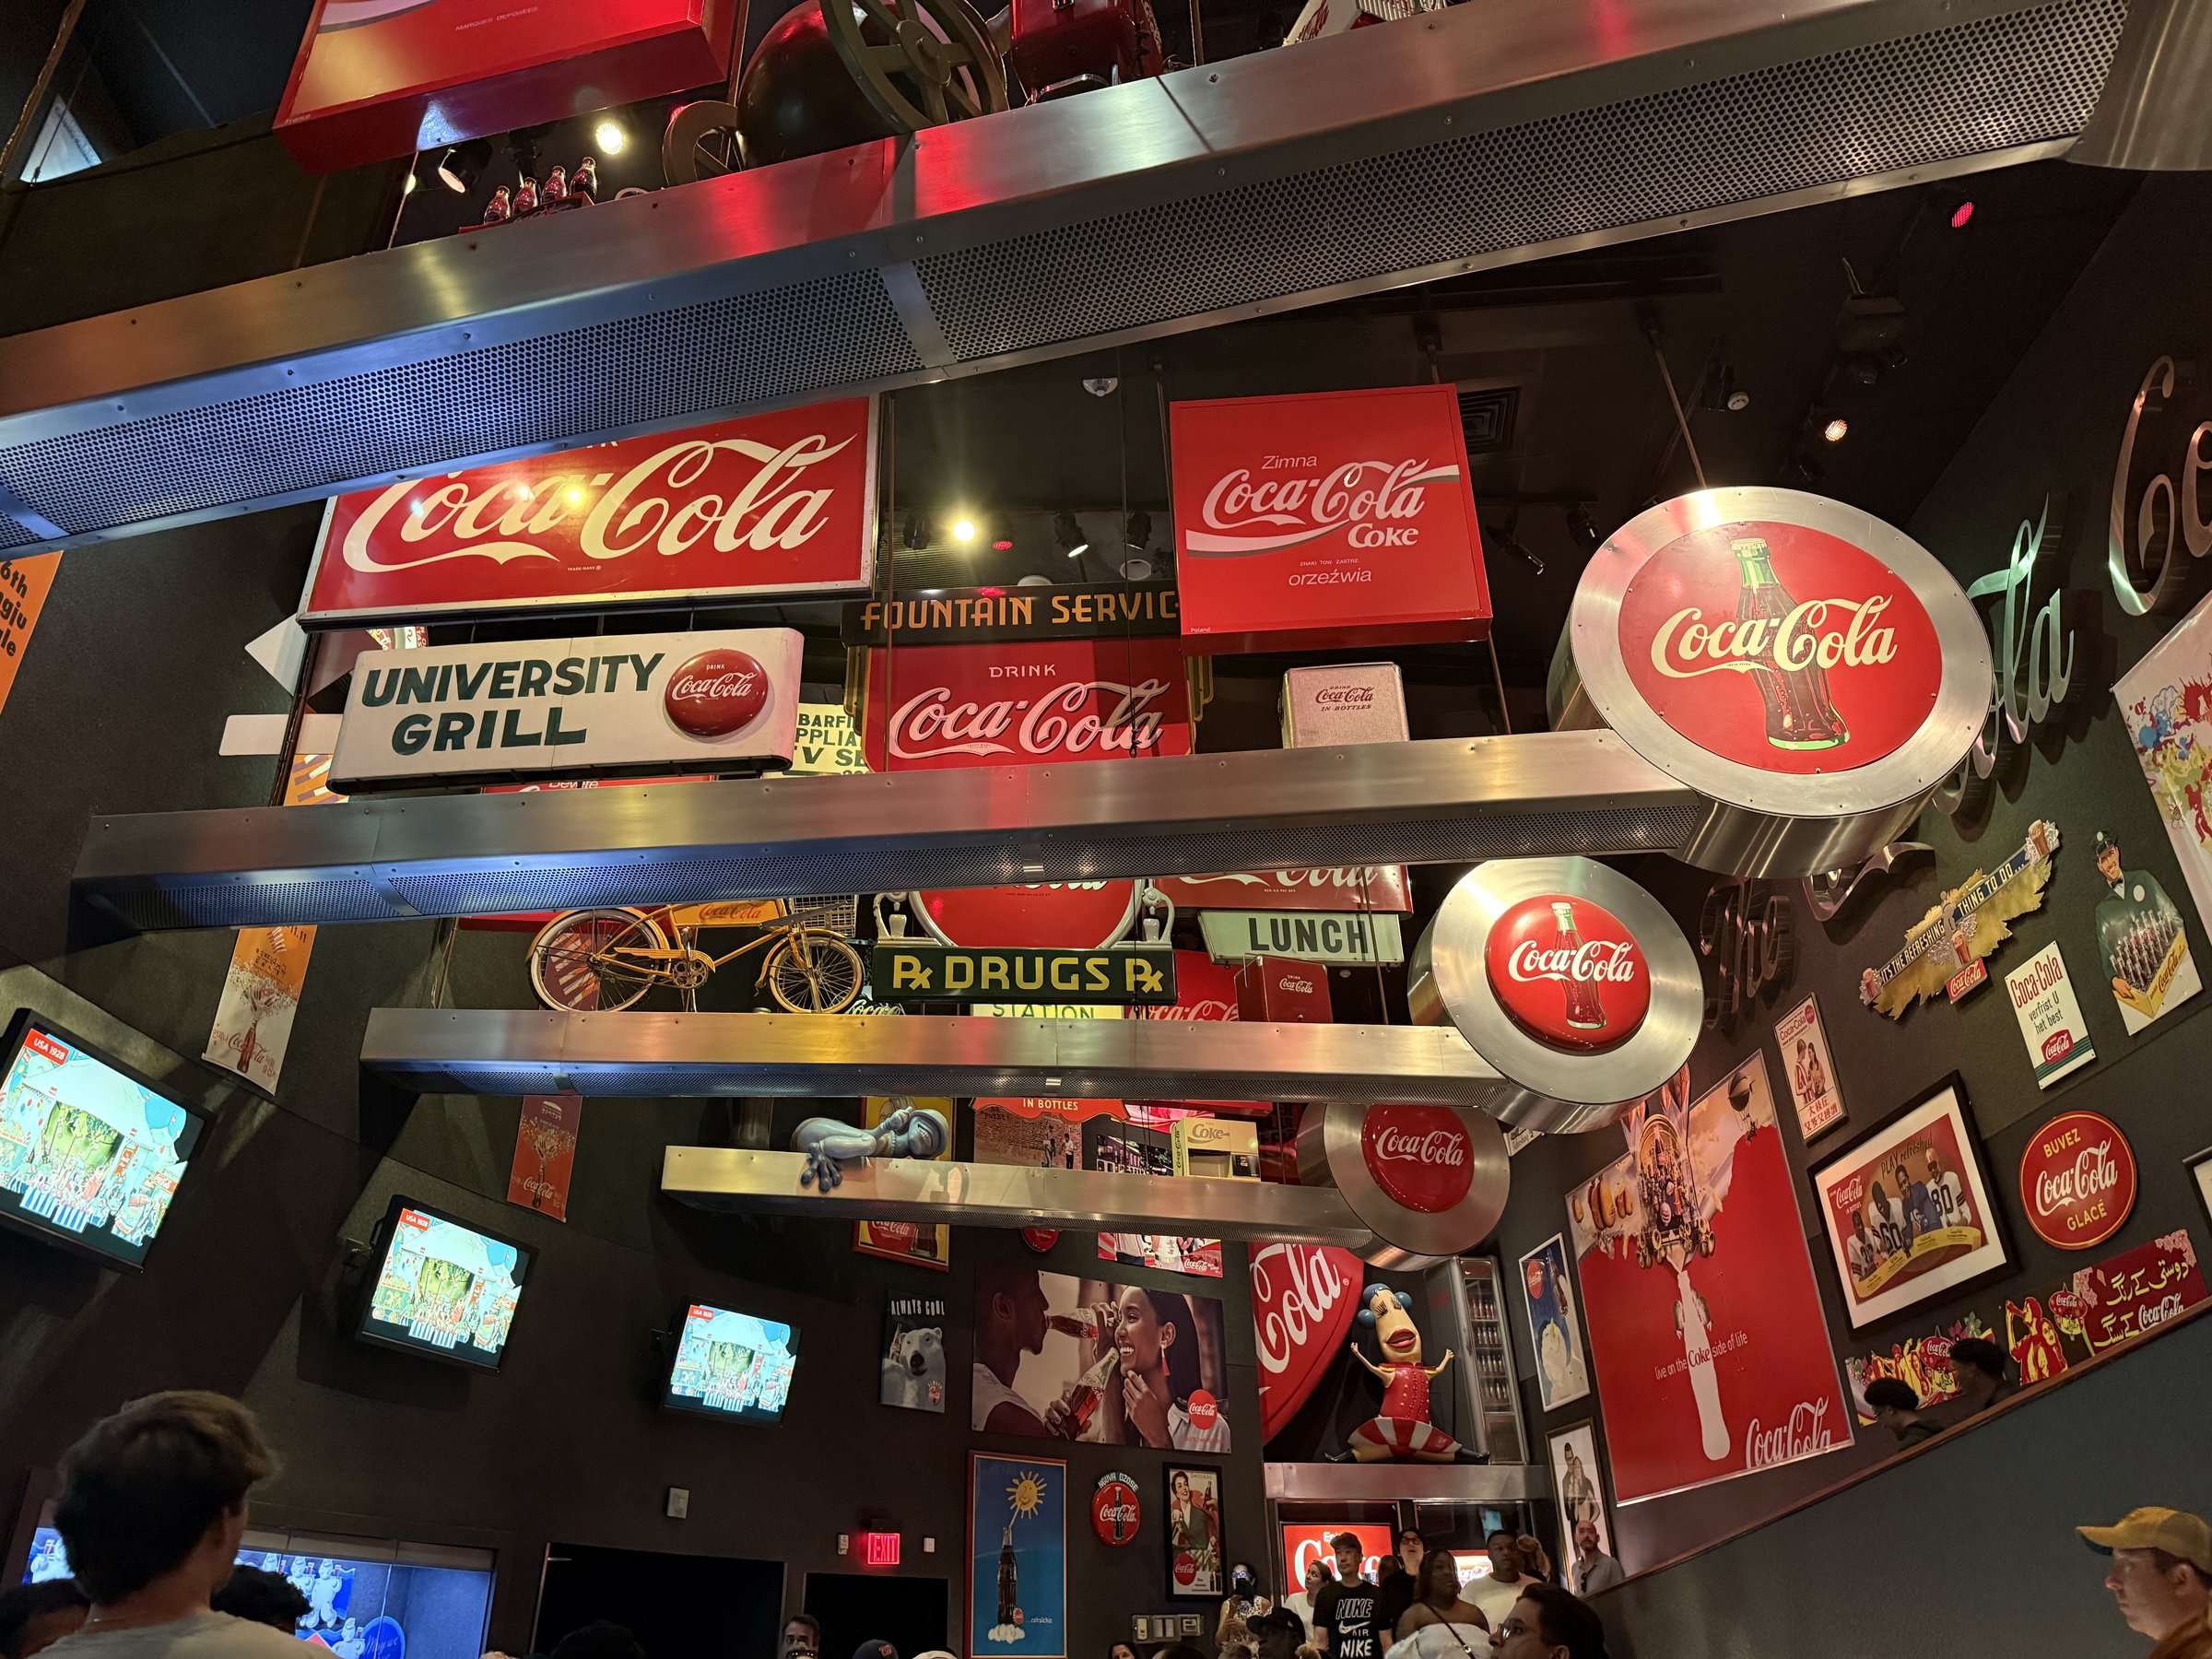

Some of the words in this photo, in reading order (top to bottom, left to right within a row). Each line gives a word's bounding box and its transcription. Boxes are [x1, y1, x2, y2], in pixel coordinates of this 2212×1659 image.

[1261, 454, 1317, 470] Zimna
[342, 432, 858, 572] Coca-Cola
[1202, 458, 1430, 530] Coca-Cola
[1347, 523, 1419, 548] Coke
[1288, 567, 1372, 586] orzeźwia
[860, 595, 1033, 631] FOUNTAIN
[1051, 590, 1180, 624] SERVIC
[1650, 593, 1899, 678] Coca-Cola
[361, 653, 665, 708] UNIVERSITY
[988, 664, 1056, 679] DRINK
[671, 672, 757, 701] Coca-Cola
[1315, 687, 1375, 704] Coca-Cola
[391, 707, 588, 757] GRILL
[888, 678, 1171, 759] Coca-Cola
[699, 902, 761, 921] Coca-Cola
[1891, 953, 1905, 975] THE
[1903, 919, 1946, 963] REFRESHING
[1957, 888, 1984, 917] THING
[1984, 876, 1998, 895] TO
[1248, 917, 1368, 954] LUNCH
[945, 955, 1111, 992] DRUGS
[1508, 939, 1635, 982] Coca-Cola
[2158, 949, 2179, 994] Coca-Cola
[1279, 977, 1313, 994] Coca-Cola
[1950, 960, 1982, 997] Coca-Cola
[2010, 954, 2064, 1008] Coca-Cola
[993, 1004, 1095, 1019] STATION
[2028, 998, 2052, 1022] verfrist
[2052, 990, 2060, 1005] U
[1780, 1016, 1806, 1041] Coca-Cola
[2033, 1018, 2048, 1036] het
[2047, 1008, 2064, 1027] best
[33, 1037, 49, 1053] USA
[49, 1046, 66, 1061] 1928
[2045, 1033, 2070, 1061] Coca-Cola
[1023, 1098, 1034, 1108] IN
[1038, 1100, 1078, 1111] BOTTLES
[1192, 1124, 1230, 1140] Coke
[1375, 1126, 1465, 1166] Coca-Cola
[2042, 1127, 2082, 1159] BUVEZ
[1880, 1151, 1900, 1180] PLAY
[1900, 1132, 1933, 1163] refreshed
[2035, 1136, 2118, 1217] Coca-Cola
[1836, 1175, 1863, 1209] Coca-Cola
[406, 1215, 417, 1224] USA
[2066, 1199, 2109, 1231] GLACÉ
[1879, 1222, 1902, 1252] 60
[1183, 1258, 1208, 1273] Coca-Cola
[890, 1299, 922, 1316] ALWAYS
[924, 1300, 946, 1316] COOL
[2056, 1293, 2077, 1307] Coca-Cola
[2138, 1292, 2184, 1332] Coca-Cola
[1654, 1365, 1667, 1380] live
[1667, 1363, 1677, 1376] on
[1676, 1358, 1688, 1372] the
[1688, 1347, 1712, 1368] Coke
[1712, 1339, 1727, 1358] side
[1727, 1334, 1735, 1350] of
[1735, 1330, 1748, 1347] life
[1926, 1340, 1955, 1357] Coca-Col
[1189, 1402, 1216, 1417] Coca-Cola
[1745, 1394, 1831, 1470] Coca-Cola
[1098, 1472, 1116, 1488] NGUVA
[1100, 1503, 1136, 1523] Coca-Cola
[874, 1535, 897, 1562] EXIT
[1175, 1563, 1194, 1574] Coca-Cola
[1335, 1598, 1374, 1620] NIKE
[1352, 1629, 1370, 1637] AIR
[1339, 1639, 1373, 1659] NIKE
